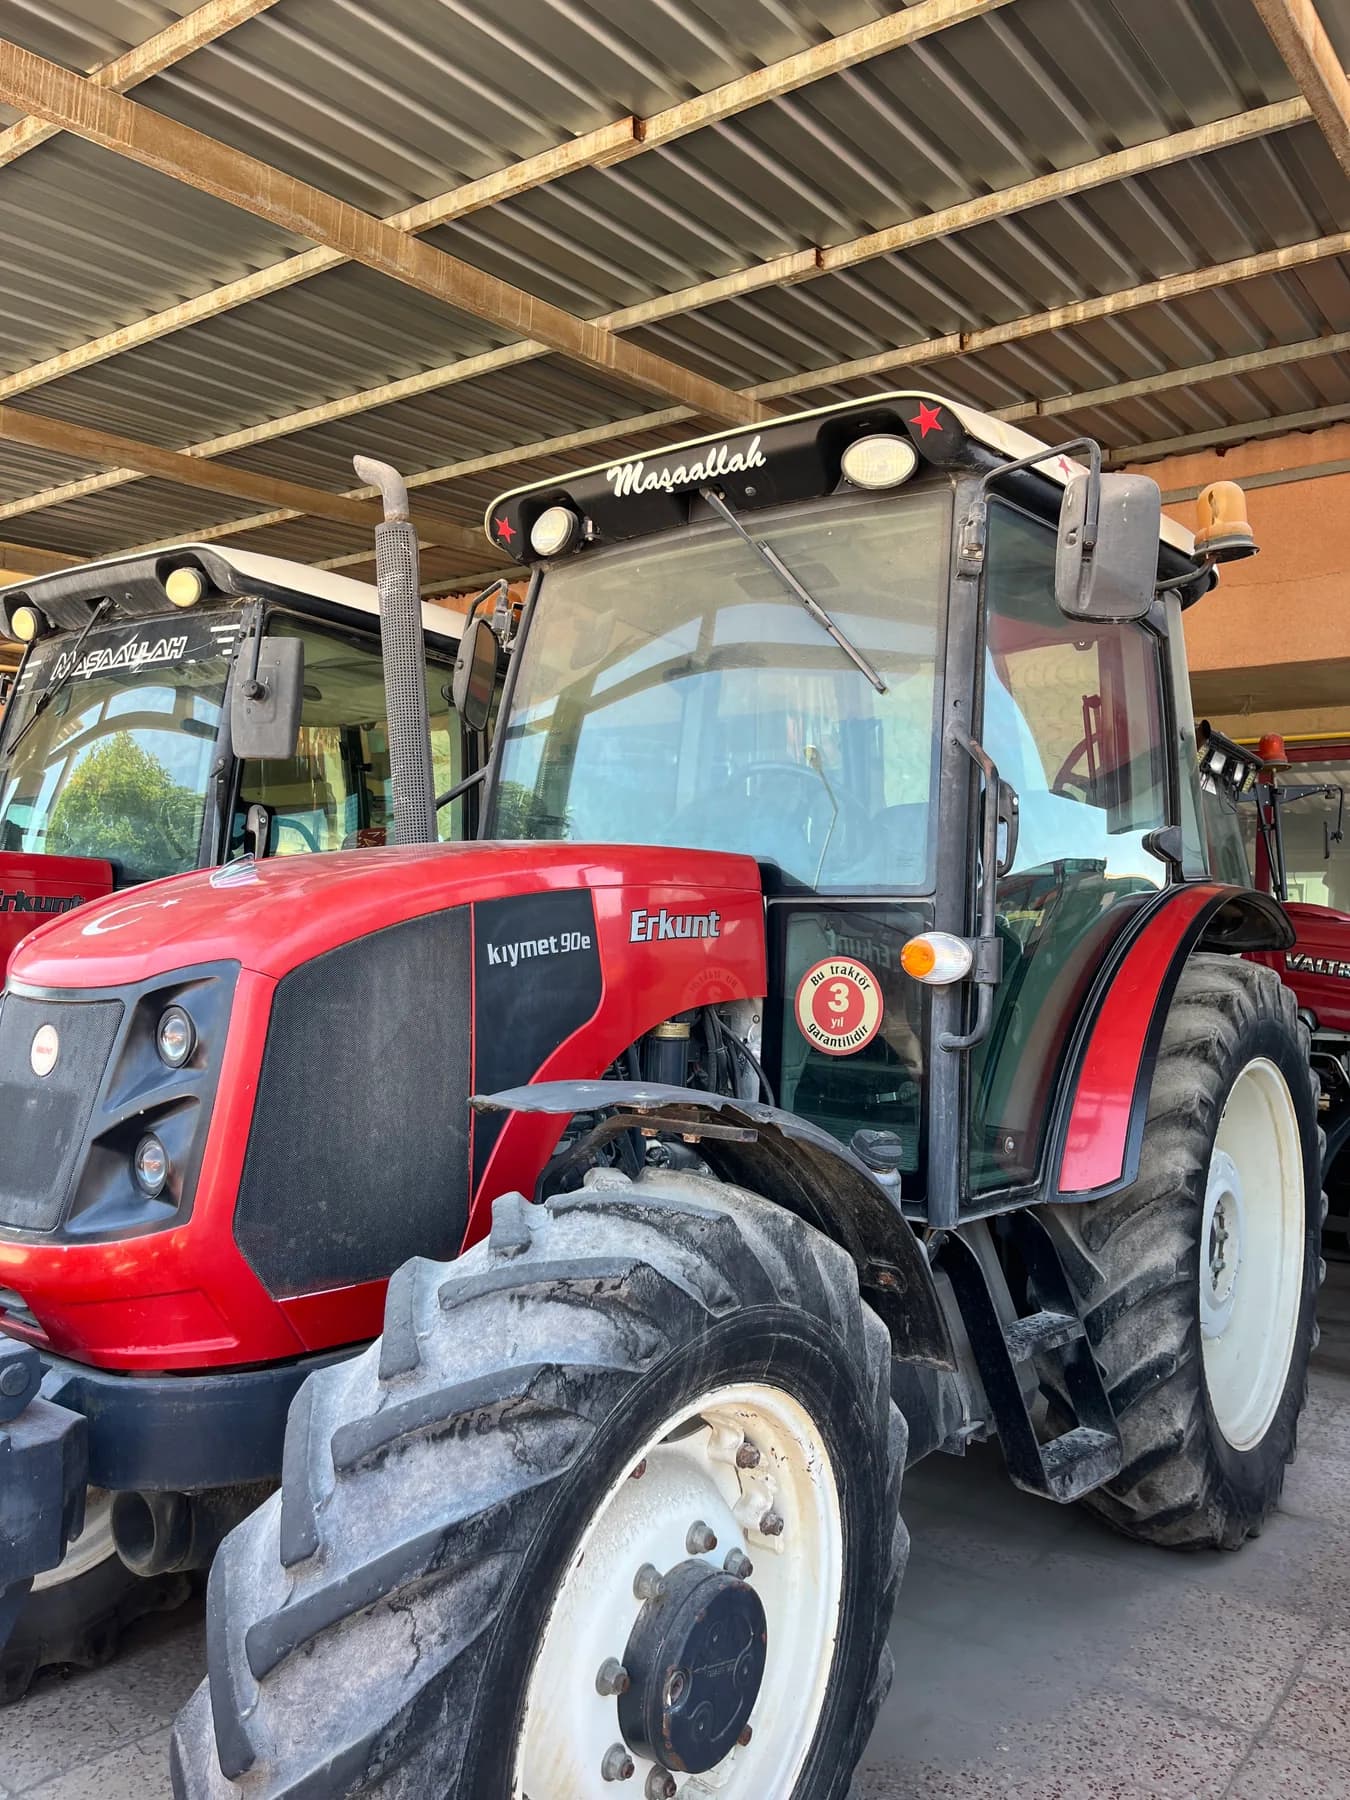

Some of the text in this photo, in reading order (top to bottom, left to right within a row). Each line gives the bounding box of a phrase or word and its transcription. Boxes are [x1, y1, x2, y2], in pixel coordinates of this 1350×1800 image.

[606, 435, 766, 497] Maşaallah
[629, 908, 721, 943] Erkunt
[810, 965, 871, 991] Bu traktör
[828, 982, 850, 1013] 3
[806, 1023, 868, 1048] garantilidir
